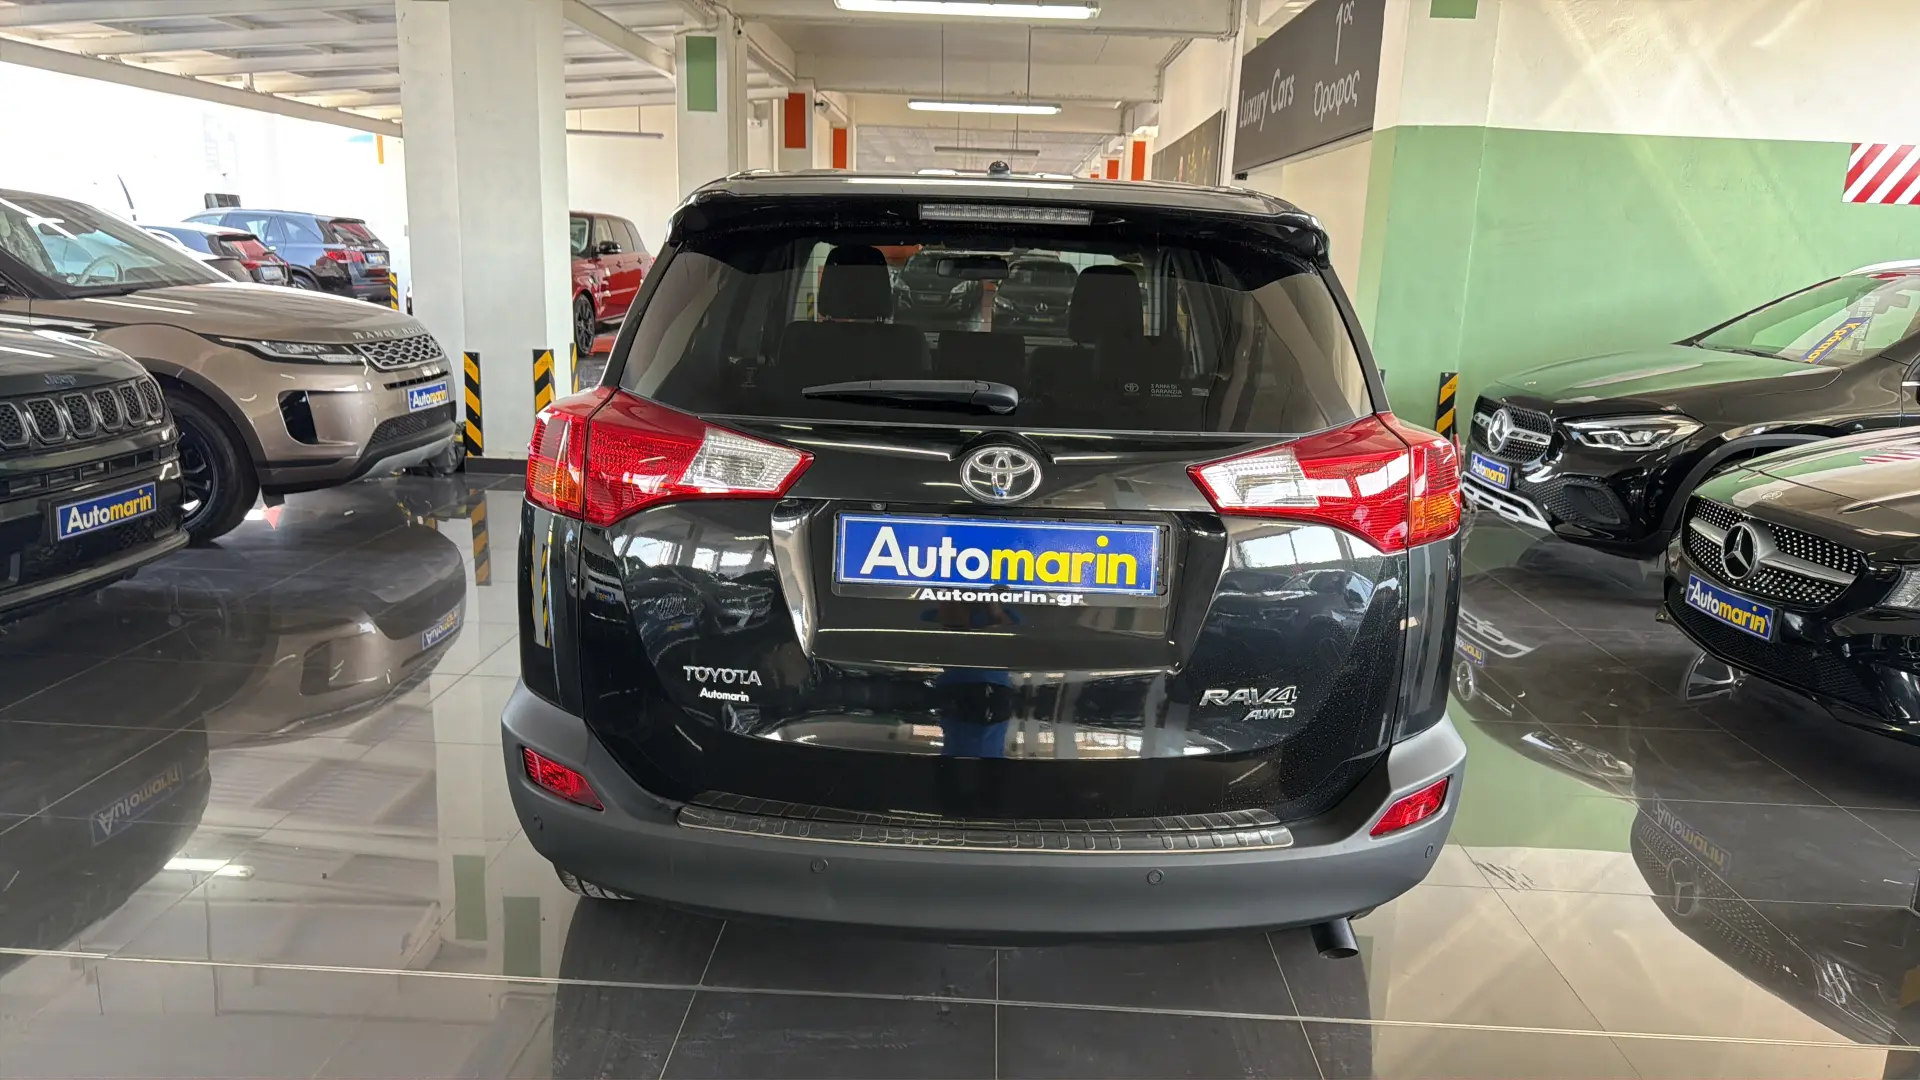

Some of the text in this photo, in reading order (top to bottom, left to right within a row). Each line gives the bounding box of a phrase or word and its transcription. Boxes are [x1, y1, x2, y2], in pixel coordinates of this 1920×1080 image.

[1239, 67, 1295, 132] Luxury Cars
[66, 488, 152, 534] Automarin
[859, 525, 1138, 585] Automarin
[919, 587, 1084, 607] Automarin.gr
[1690, 580, 1766, 634] Automarin
[683, 665, 762, 686] TOYOTA
[699, 687, 750, 702] Automarin
[1199, 685, 1298, 706] RAV4
[1242, 707, 1296, 721] AWD
